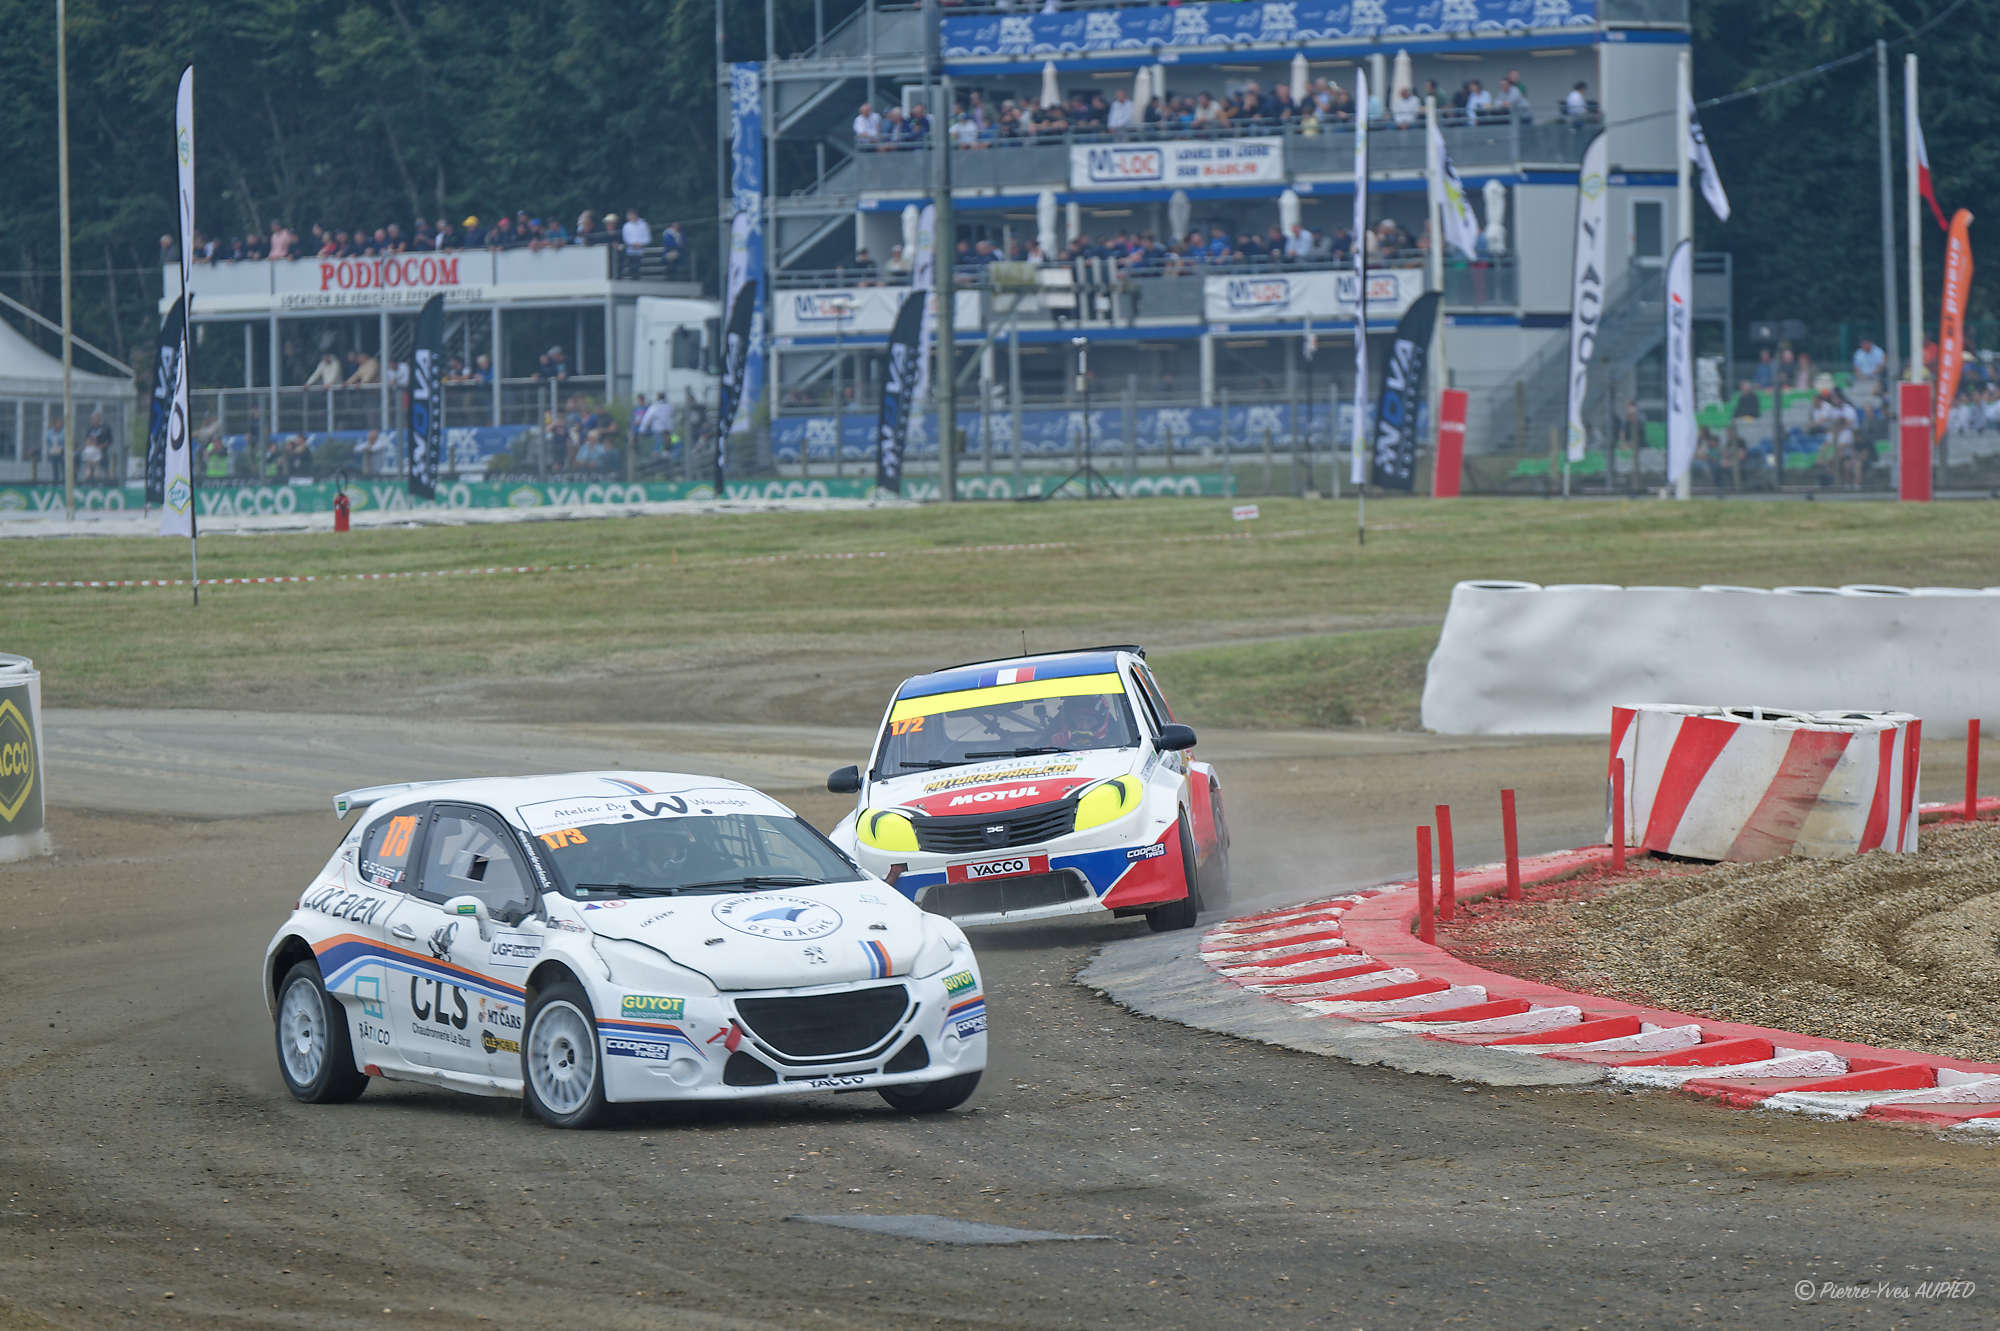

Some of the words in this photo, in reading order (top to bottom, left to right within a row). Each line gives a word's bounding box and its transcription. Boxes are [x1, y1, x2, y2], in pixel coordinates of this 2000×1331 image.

[320, 257, 459, 291] PODIOCOM
[200, 486, 297, 516] YACCO
[547, 484, 648, 507] YACCO
[890, 716, 926, 737] 172
[949, 786, 1040, 807] MOTUL
[553, 803, 602, 819] Atelier
[379, 815, 417, 857] 173
[539, 827, 589, 850] 173
[1126, 843, 1165, 859] COOPER
[972, 859, 1024, 877] YACCO
[747, 924, 771, 935] DE
[491, 942, 513, 956] UGF
[944, 970, 974, 991] GUYOT
[410, 975, 468, 1030] CLS
[623, 995, 683, 1011] GUYOT
[499, 1011, 521, 1030] CARS
[606, 1039, 669, 1054] COOPER
[807, 1075, 865, 1088] YACCO
